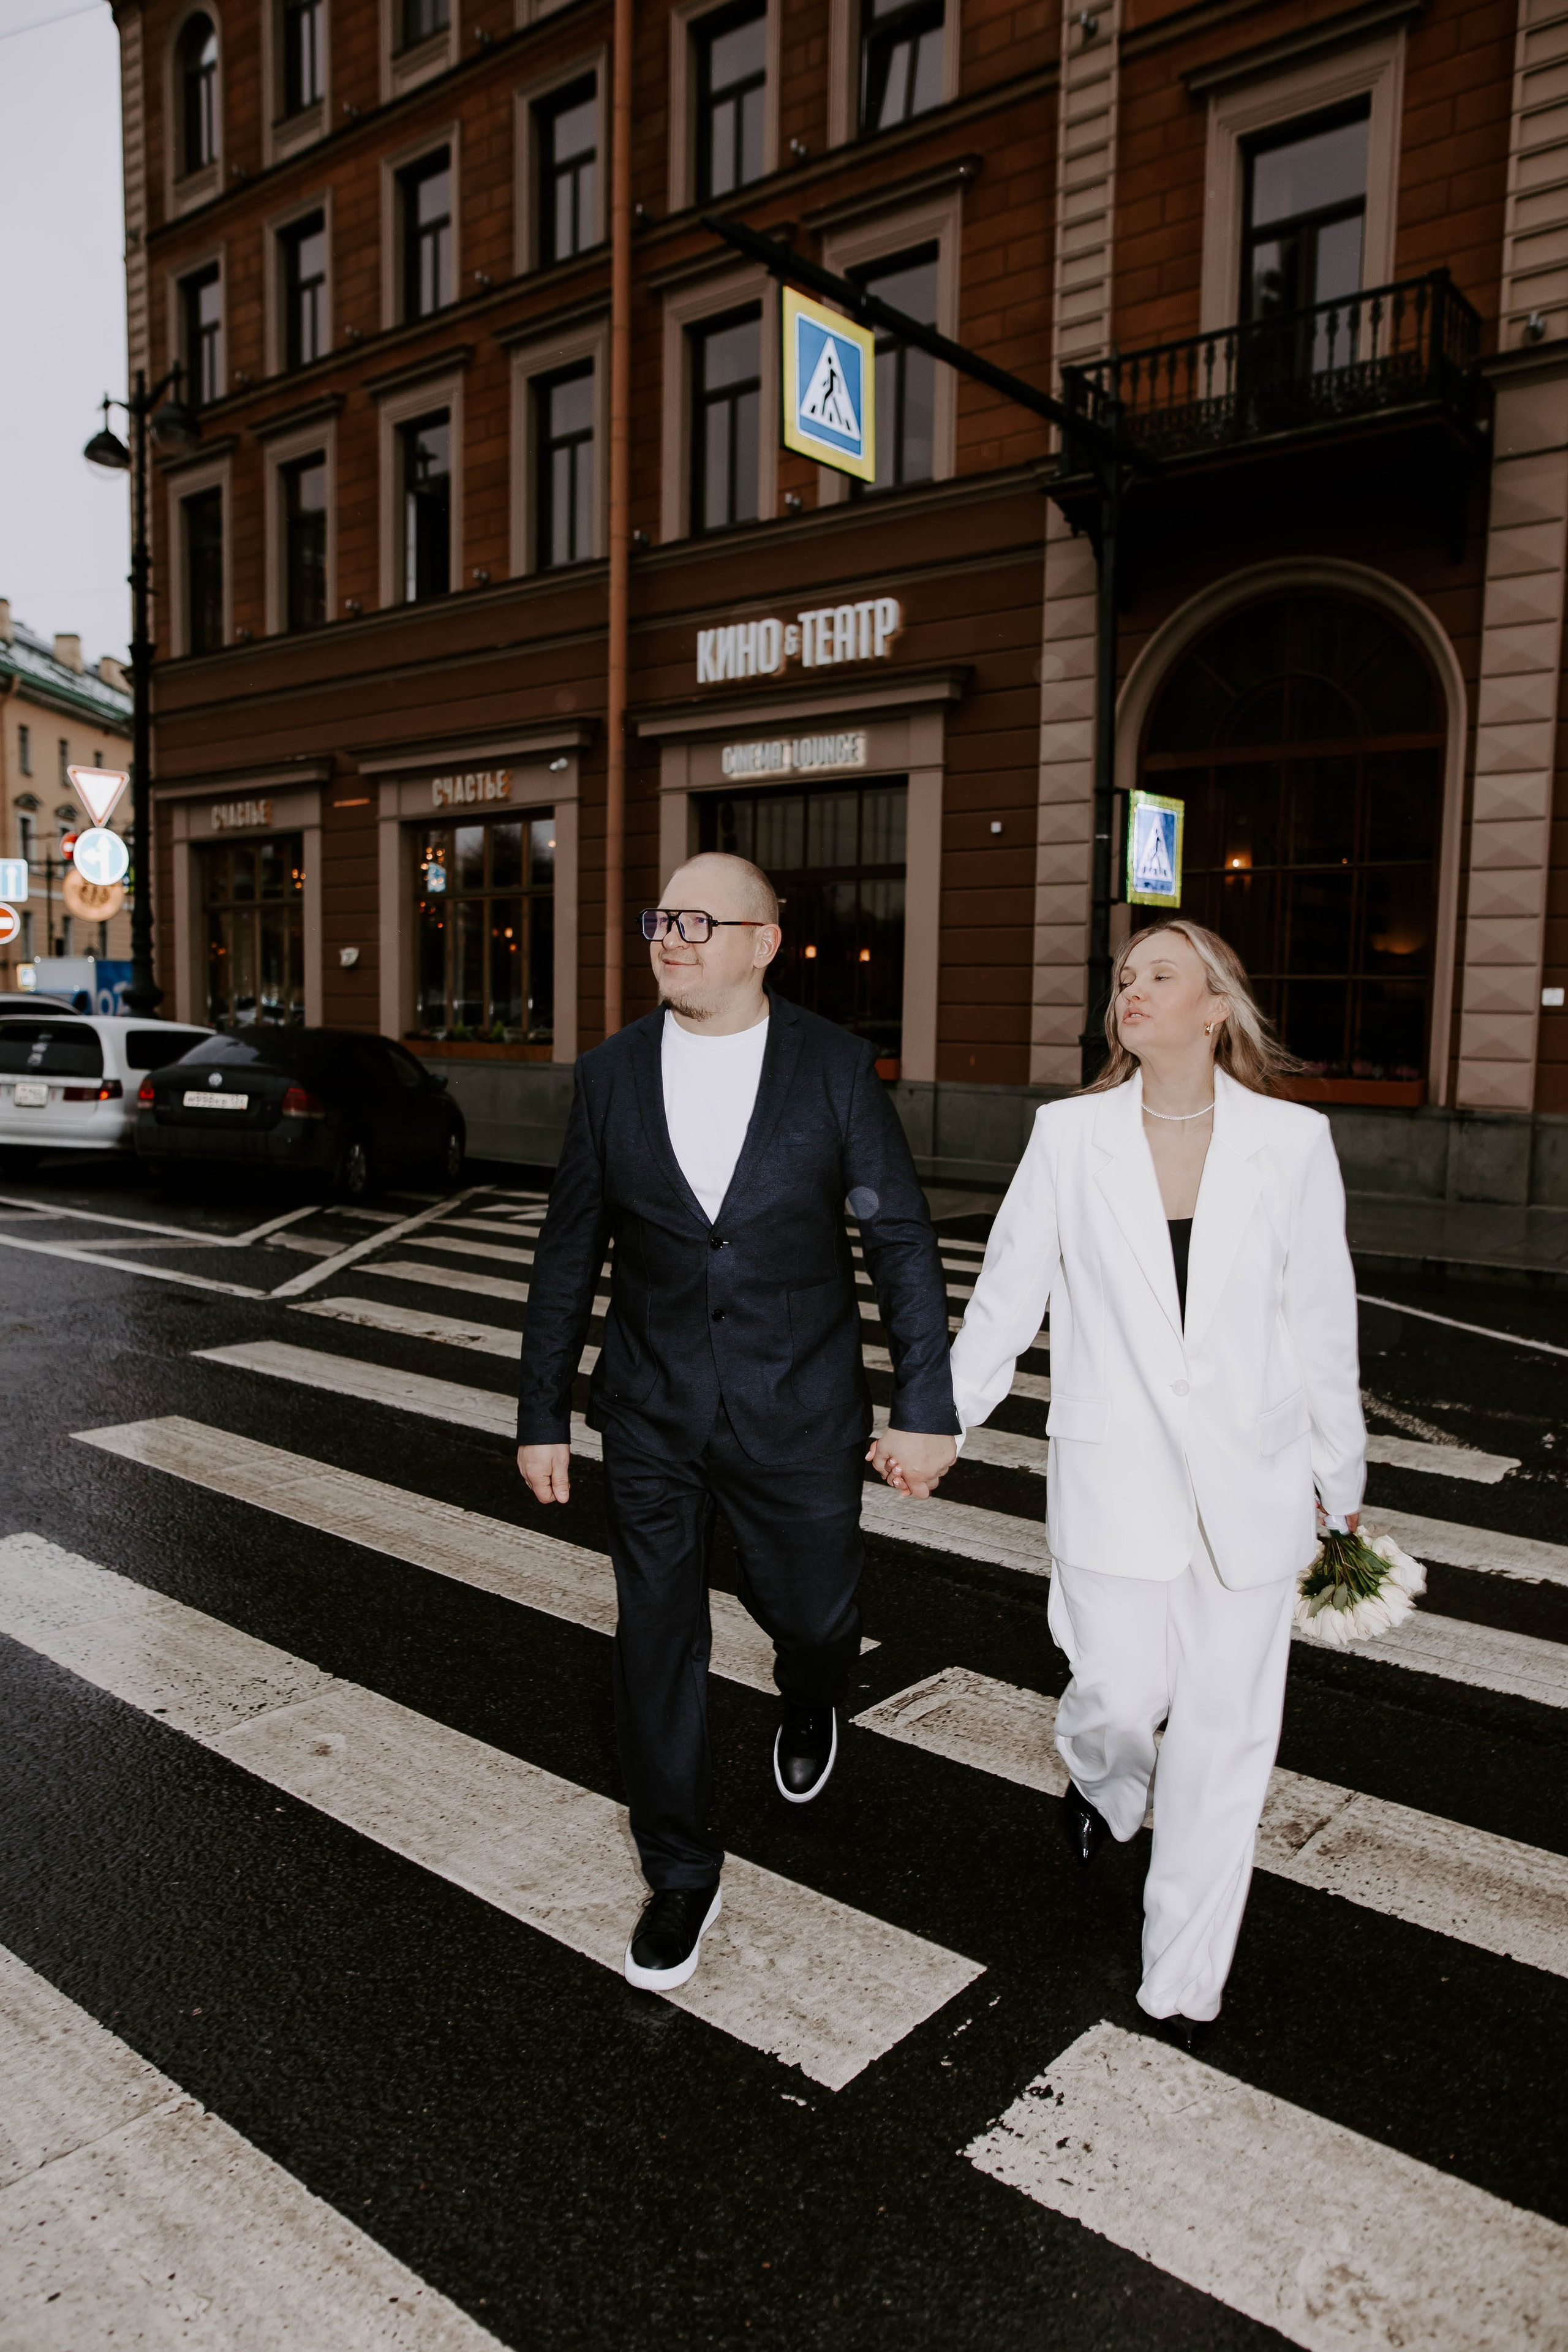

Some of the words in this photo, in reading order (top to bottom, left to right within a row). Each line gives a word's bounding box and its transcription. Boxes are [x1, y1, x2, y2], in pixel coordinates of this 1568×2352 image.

[722, 741, 783, 774] CINEMA
[792, 732, 859, 767] LOUNGE
[432, 769, 507, 807] СЧАСТЬЕ
